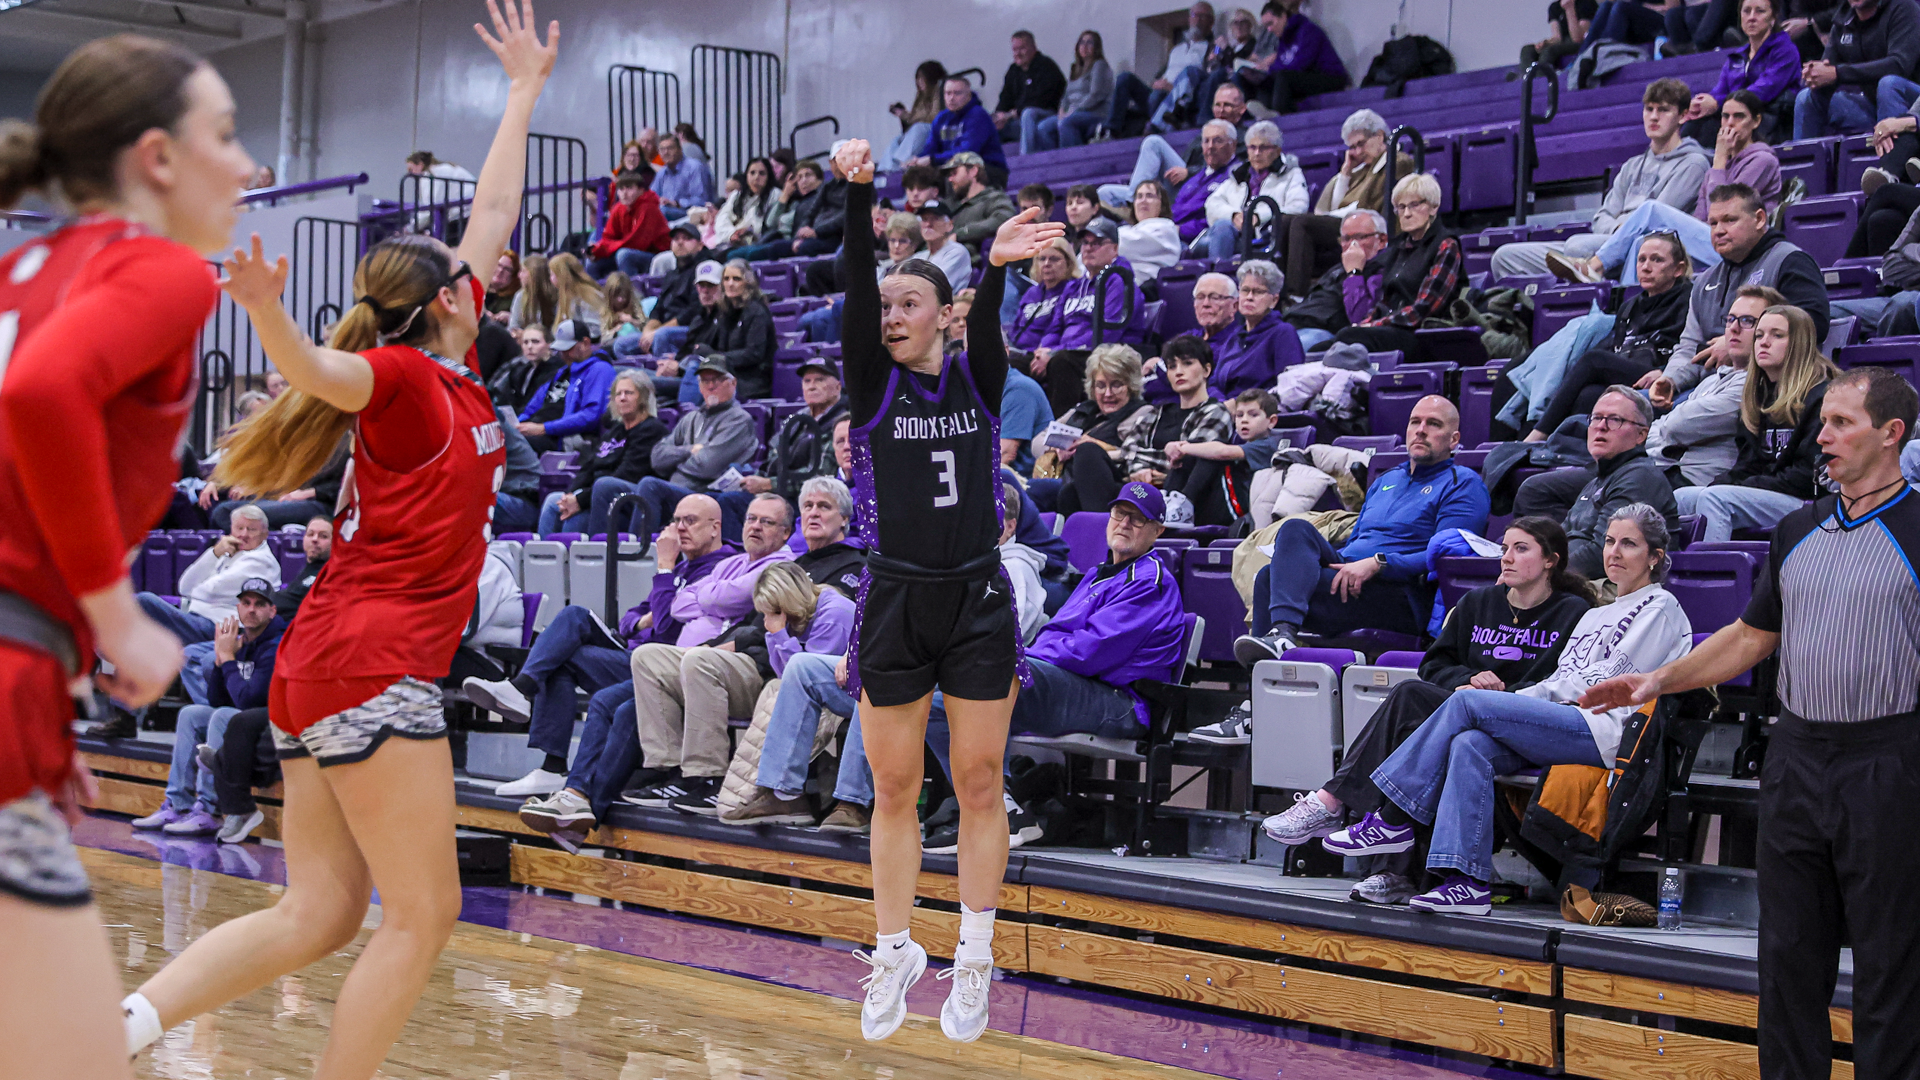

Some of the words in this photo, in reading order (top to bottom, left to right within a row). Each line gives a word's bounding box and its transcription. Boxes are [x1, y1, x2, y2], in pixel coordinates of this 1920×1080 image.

[893, 416, 939, 439] SIOUX
[931, 450, 959, 508] 3
[1470, 624, 1512, 646] SIOUX
